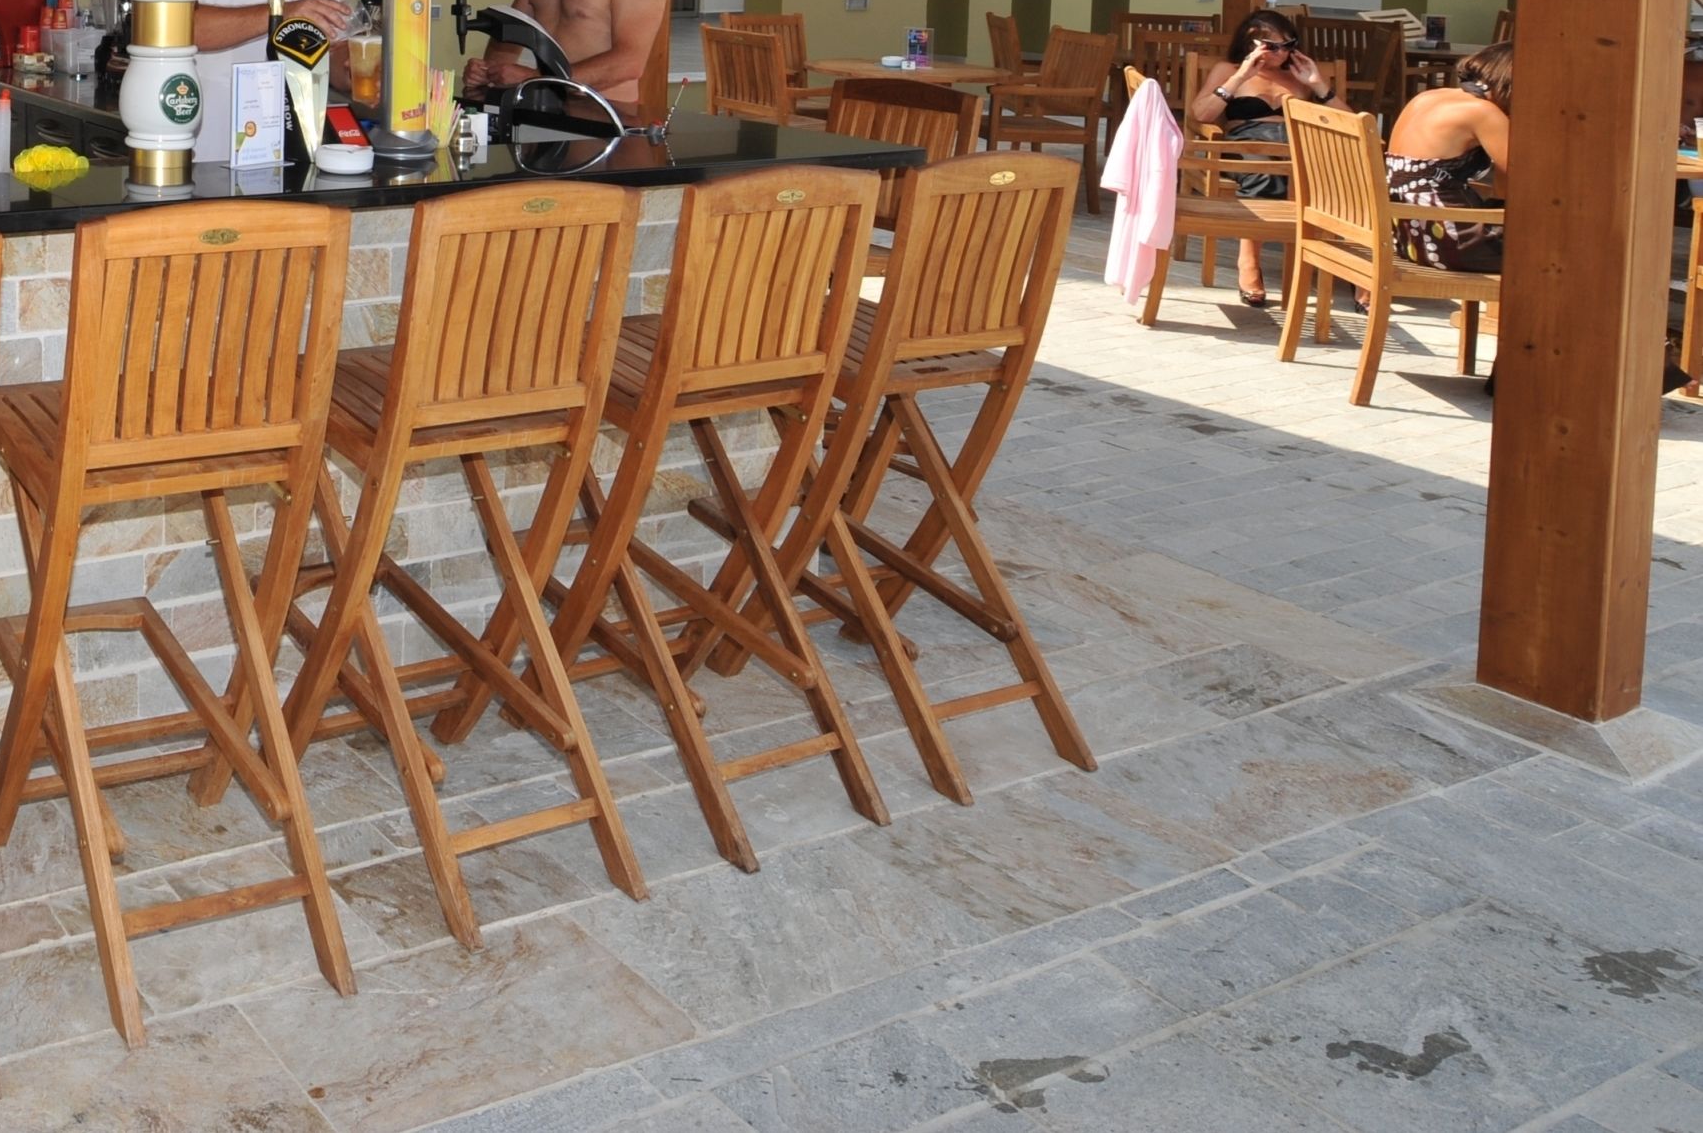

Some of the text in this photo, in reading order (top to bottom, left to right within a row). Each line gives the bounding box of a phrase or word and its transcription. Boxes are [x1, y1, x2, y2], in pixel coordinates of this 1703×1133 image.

[275, 22, 327, 42] STRONGBOW
[165, 93, 198, 108] Carlsberg
[174, 107, 193, 116] Beer
